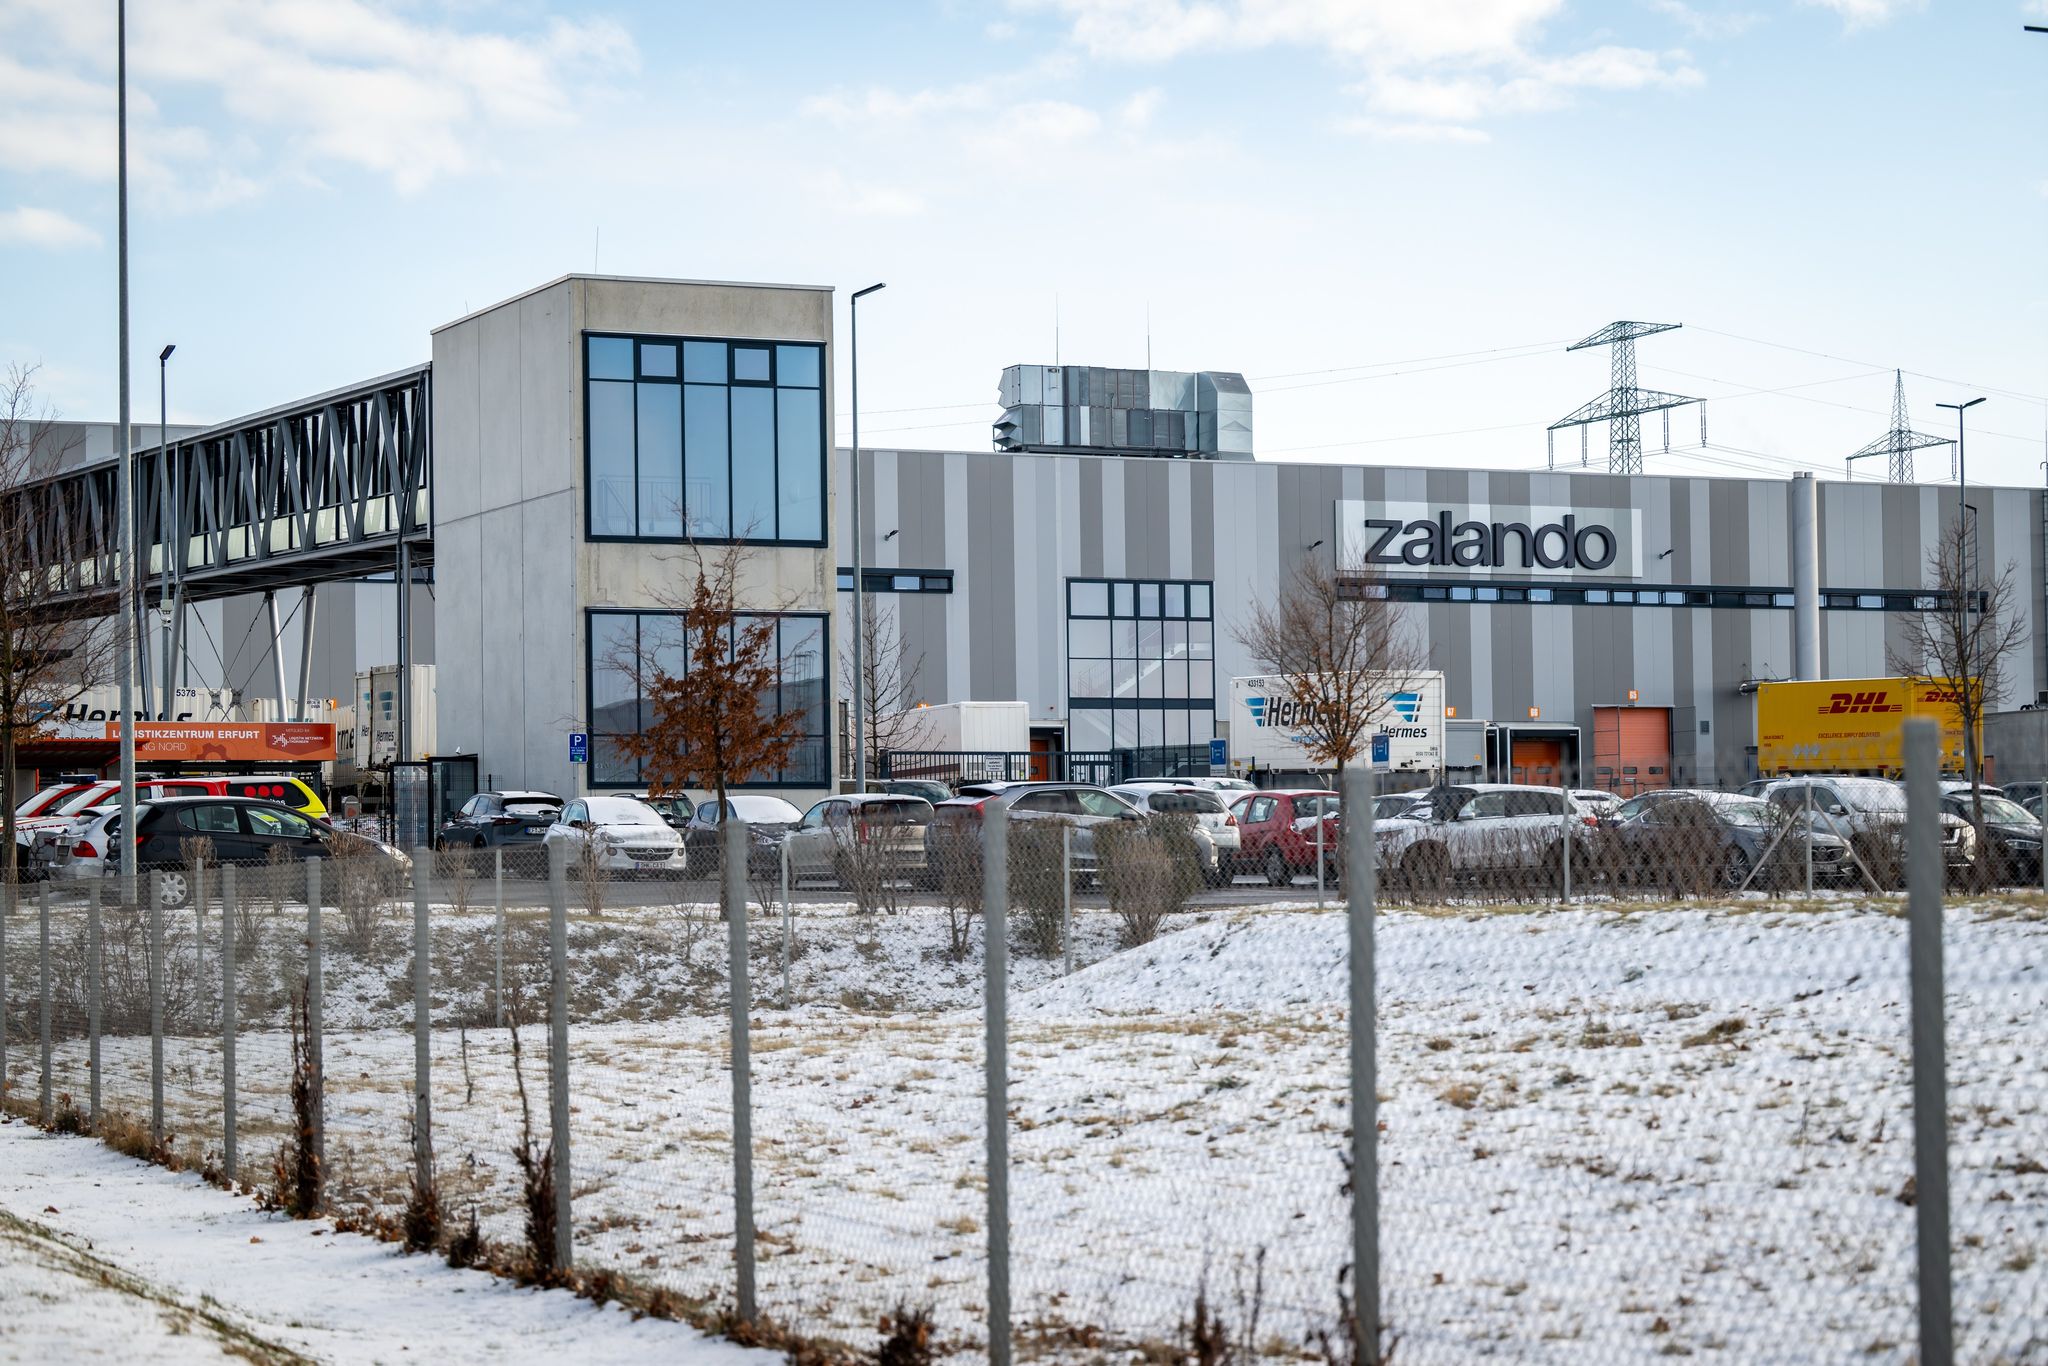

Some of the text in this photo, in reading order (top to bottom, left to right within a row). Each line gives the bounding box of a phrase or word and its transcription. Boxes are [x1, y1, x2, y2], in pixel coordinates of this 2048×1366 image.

[1364, 510, 1617, 570] zalando
[176, 689, 196, 697] 5378
[1830, 692, 1891, 714] DHL
[112, 729, 260, 739] LISTIKZENTRUM ERFURT
[376, 730, 394, 742] Hermes
[1380, 723, 1427, 738] Hermes
[574, 735, 582, 746] P
[158, 742, 187, 751] NORD
